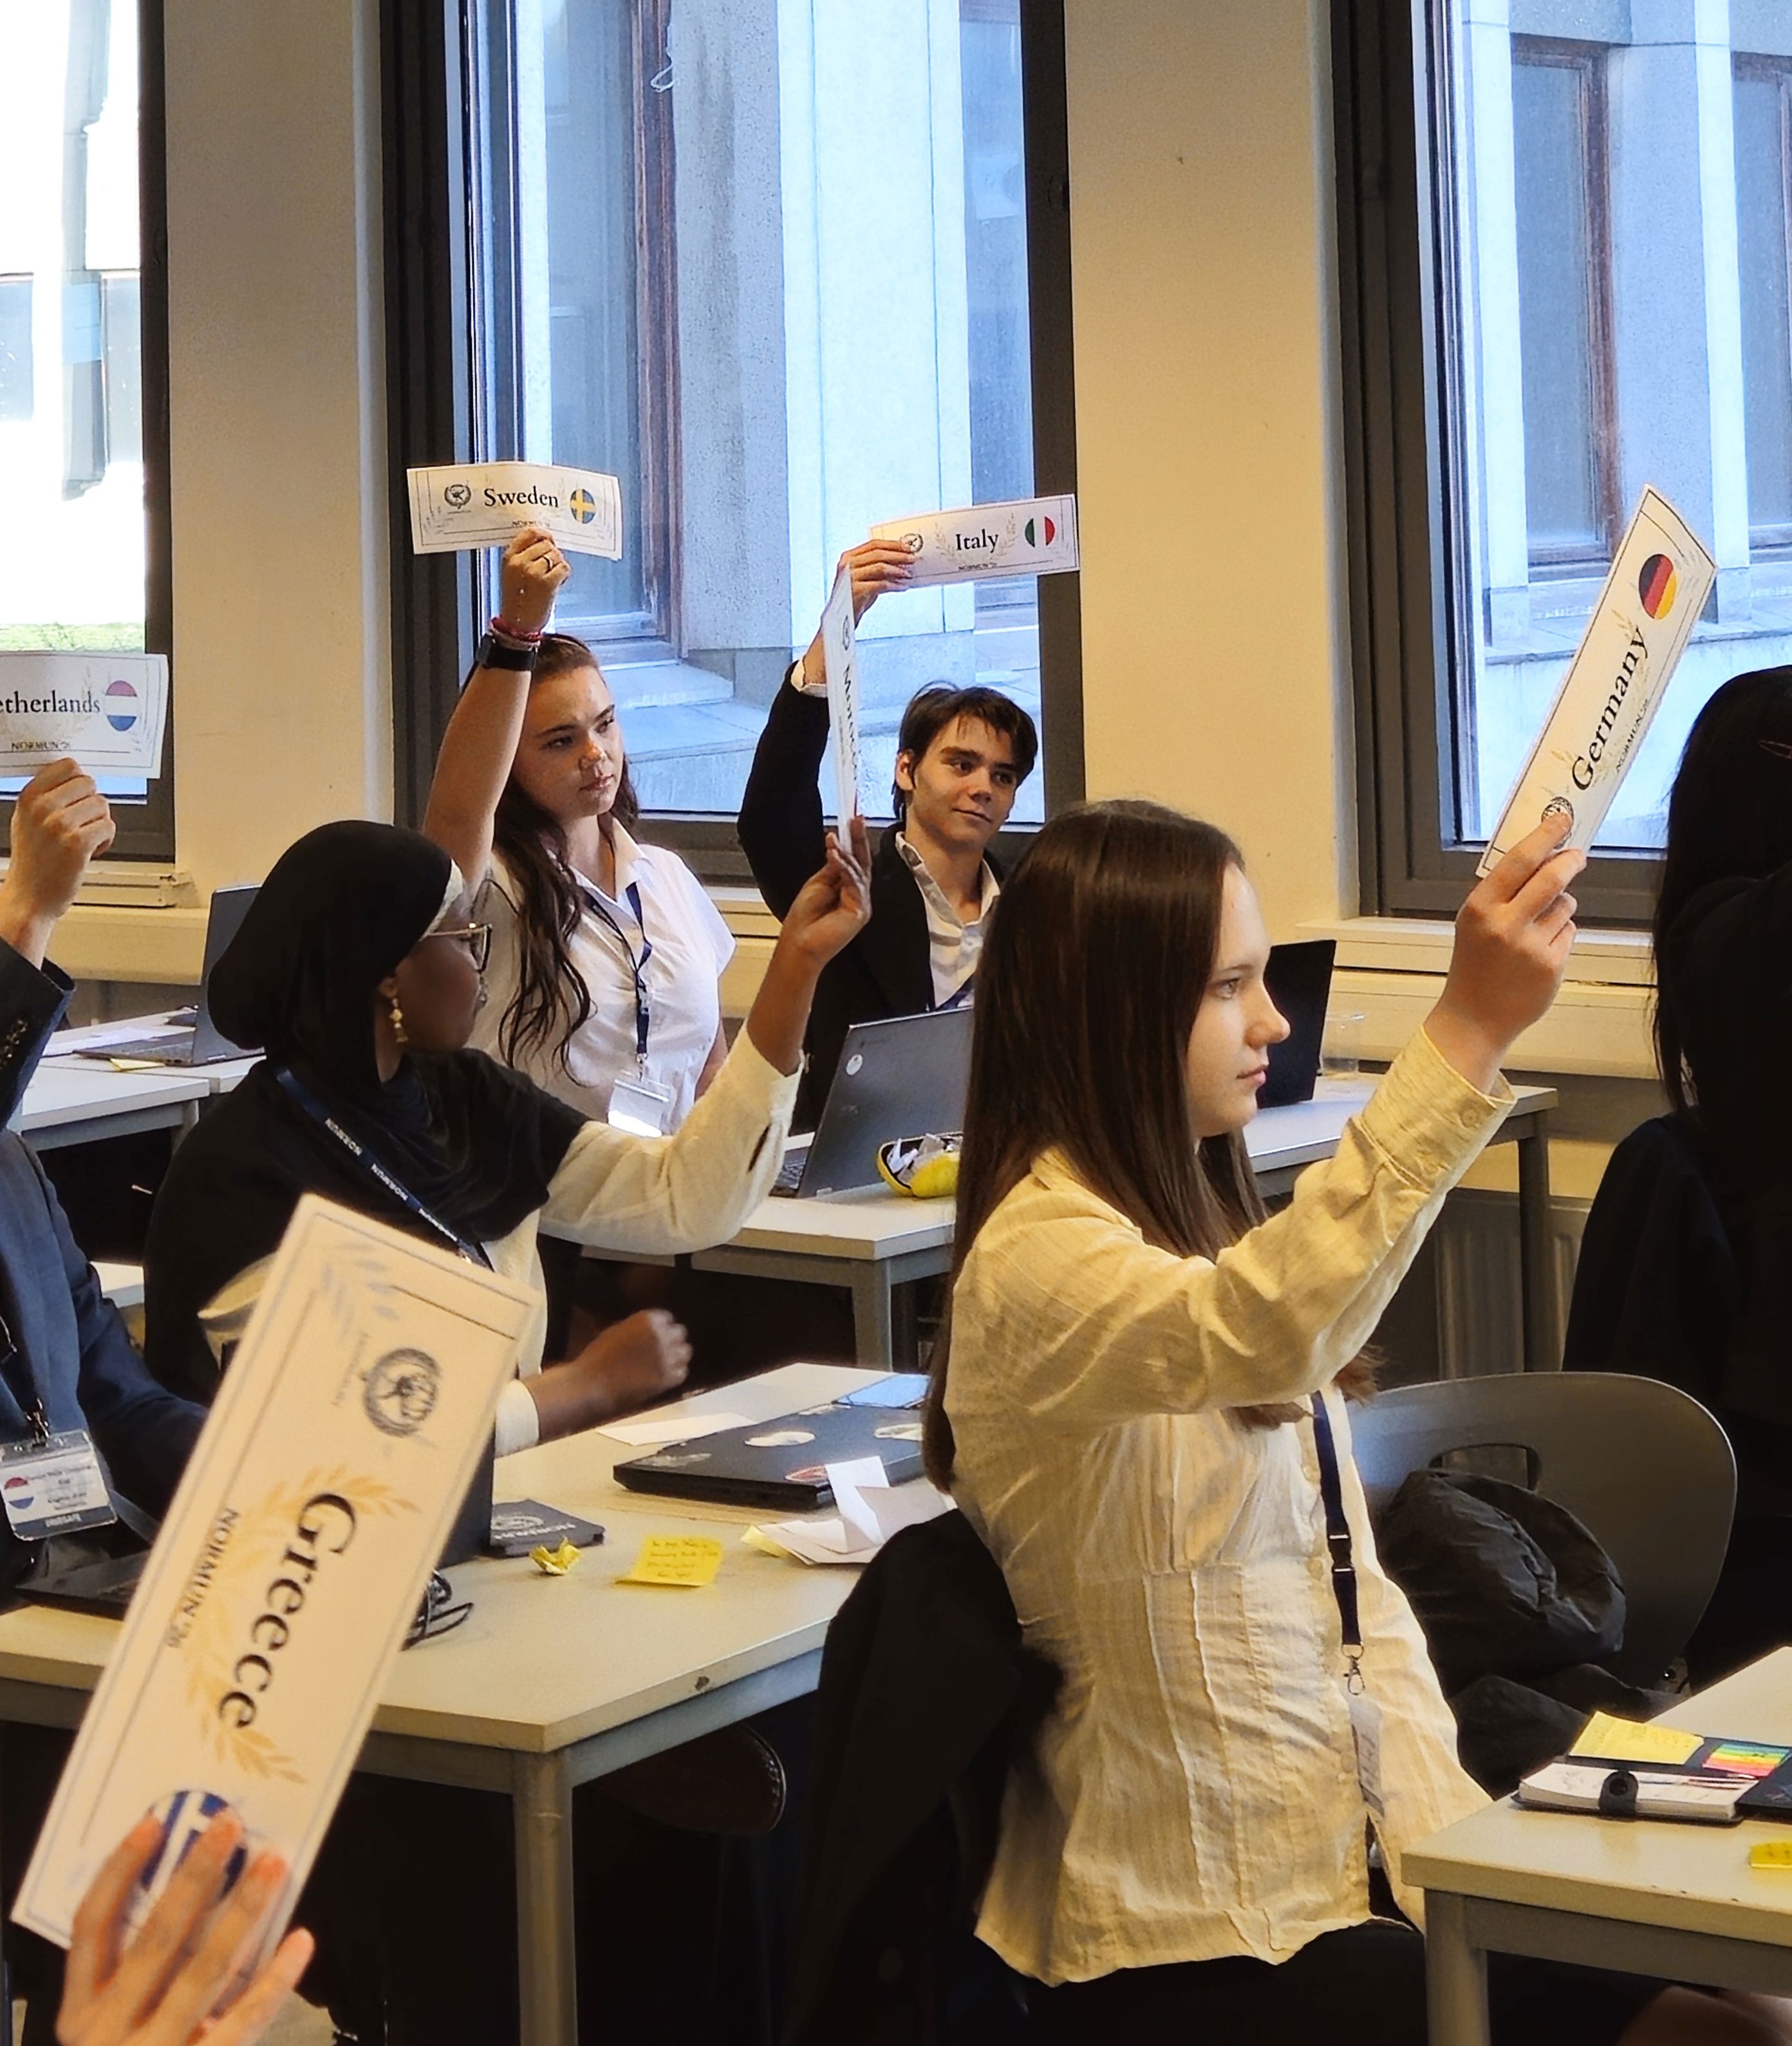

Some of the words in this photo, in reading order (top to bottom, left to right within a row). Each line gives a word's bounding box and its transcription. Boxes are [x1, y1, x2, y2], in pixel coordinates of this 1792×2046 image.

[484, 486, 559, 508] Sweden
[955, 528, 999, 553] Italy
[1572, 626, 1648, 790] Germany
[325, 1118, 362, 1156] NORMUN
[371, 1164, 408, 1201] NORMUN
[182, 1508, 239, 1617] NORMUN
[218, 1493, 356, 1729] Greece
